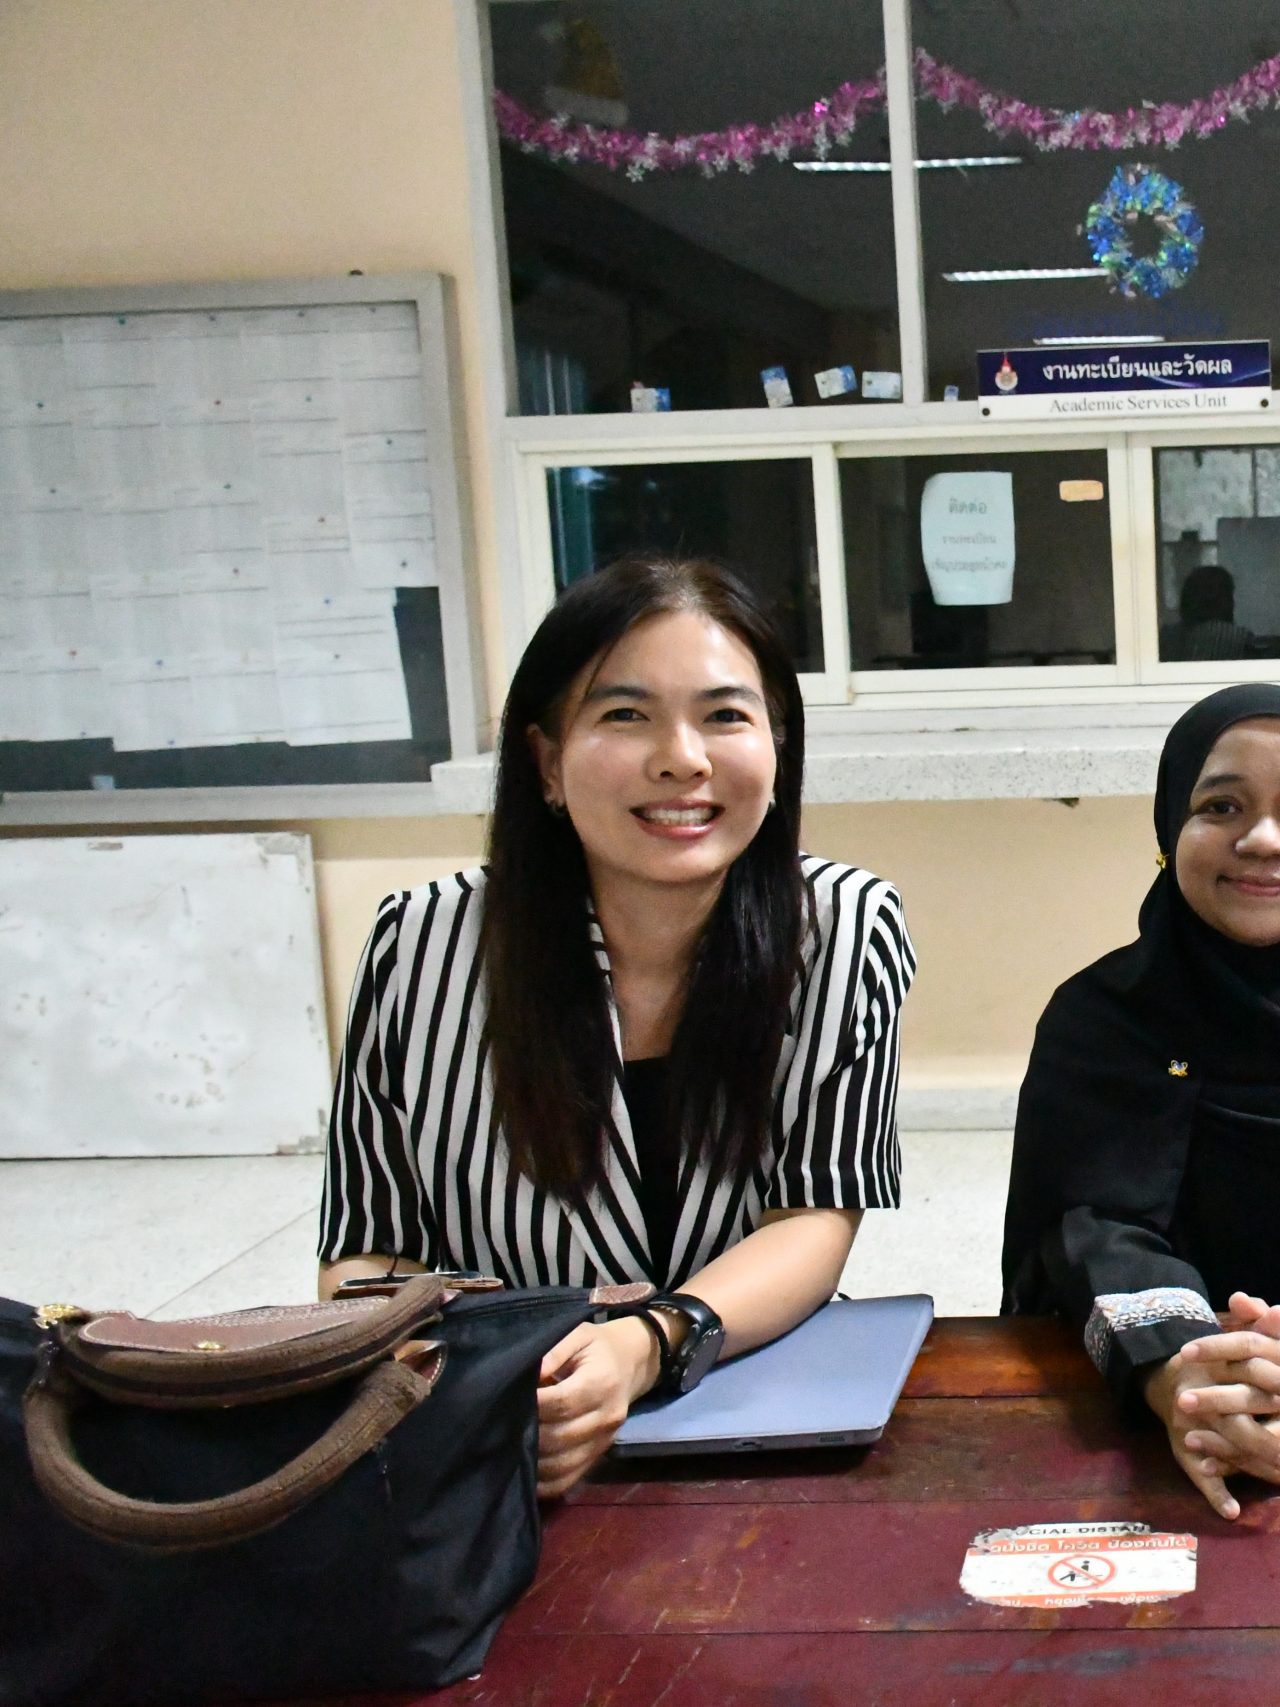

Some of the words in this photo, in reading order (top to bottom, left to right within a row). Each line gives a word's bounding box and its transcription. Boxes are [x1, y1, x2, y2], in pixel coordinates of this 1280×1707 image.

[1042, 353, 1233, 380] งานทะเบียนและวัดผล
[1050, 398, 1124, 413] Academic
[1128, 395, 1192, 411] Services
[1195, 394, 1227, 409] Unit
[1078, 1524, 1146, 1534] DISTAN
